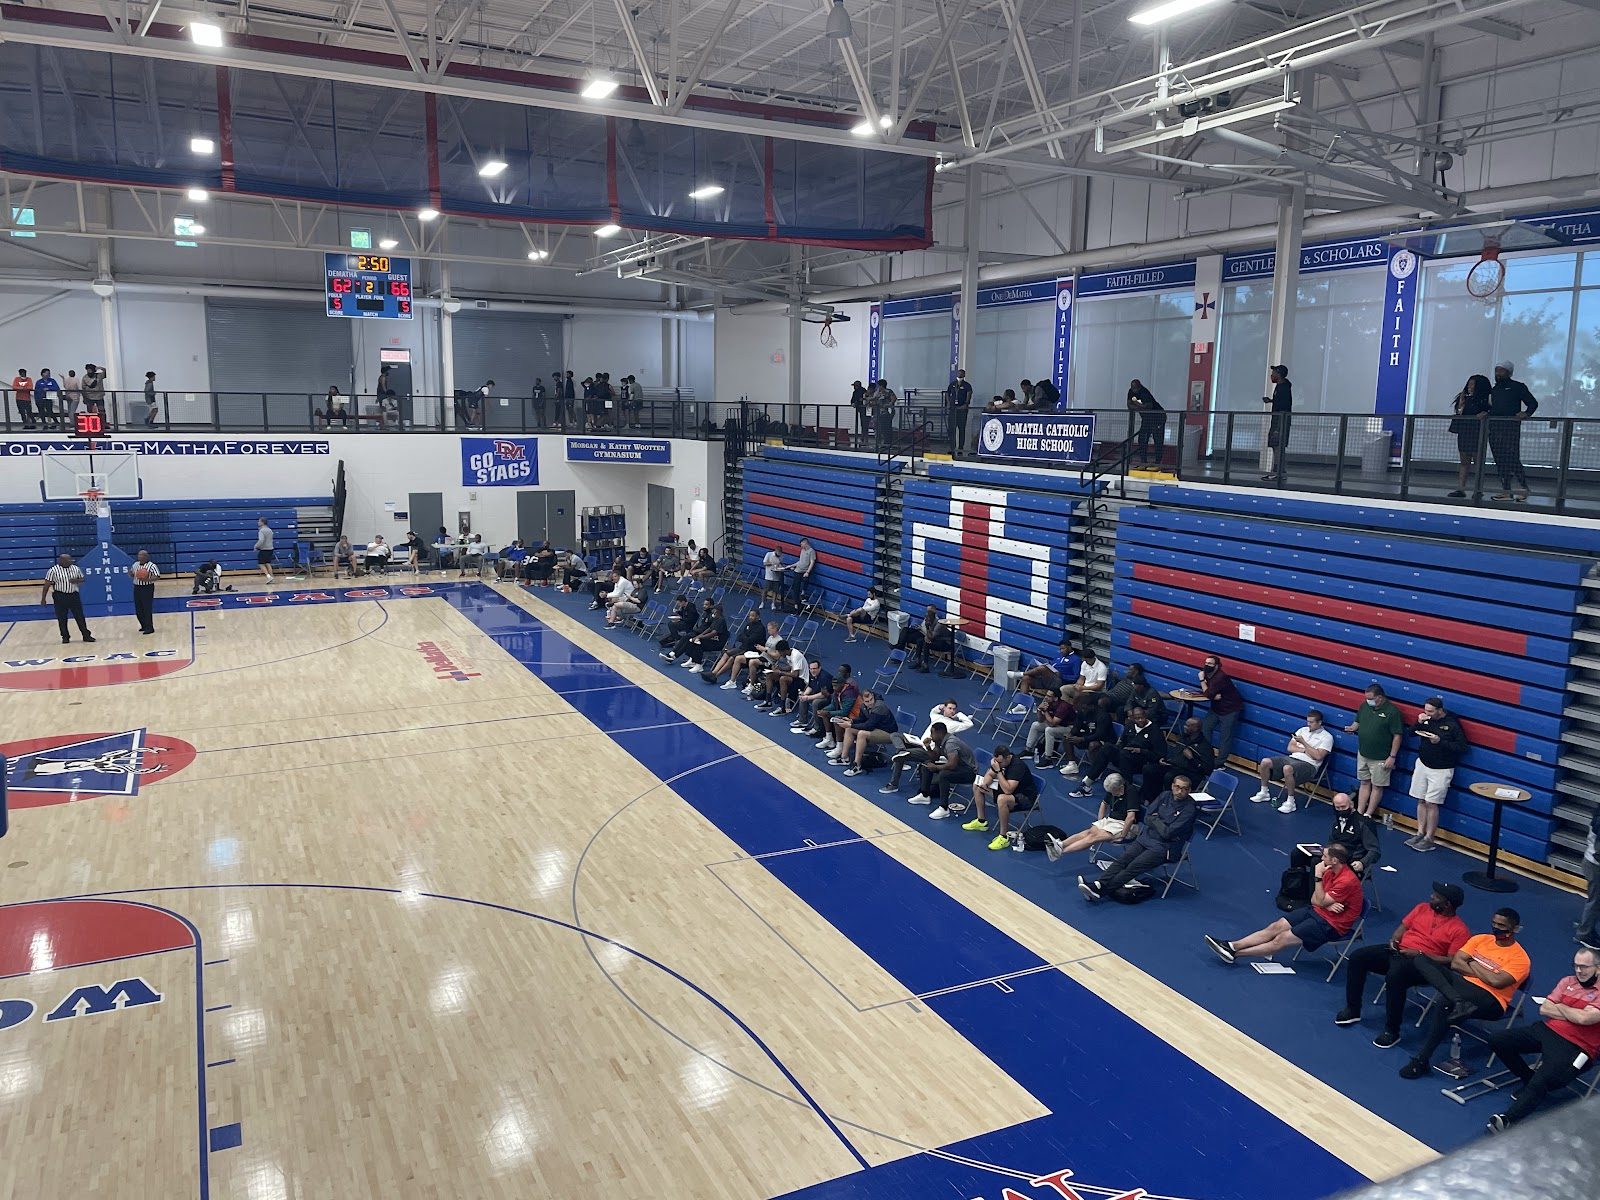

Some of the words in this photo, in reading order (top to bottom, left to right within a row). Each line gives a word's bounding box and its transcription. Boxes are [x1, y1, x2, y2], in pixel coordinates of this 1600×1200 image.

[358, 255, 389, 272] 2:50
[1231, 258, 1275, 274] GENTLE
[1303, 254, 1311, 265] &
[1313, 243, 1382, 264] SCHOLARS
[328, 270, 358, 278] DEMATHA
[1106, 271, 1164, 288] FAITH-FILLED
[333, 279, 352, 293] 62
[366, 282, 374, 293] 2
[391, 282, 409, 296] 66
[333, 299, 341, 309] 5
[402, 302, 409, 312] 5
[1389, 280, 1405, 366] FAITH
[76, 415, 101, 432] 30
[1006, 423, 1044, 435] DEMATHA
[1046, 424, 1089, 437] CATHOLIC
[633, 443, 665, 451] WOOTTEN
[1017, 438, 1038, 450] HIGH
[1041, 439, 1074, 452] SCHOOL
[470, 452, 494, 471] GO
[594, 451, 641, 459] GYMNASIUM
[477, 461, 531, 484] STAGS
[86, 566, 129, 575] STAGS
[102, 542, 113, 601] DEMATHA
[186, 586, 434, 608] STAGS
[4, 650, 178, 668] WCAC
